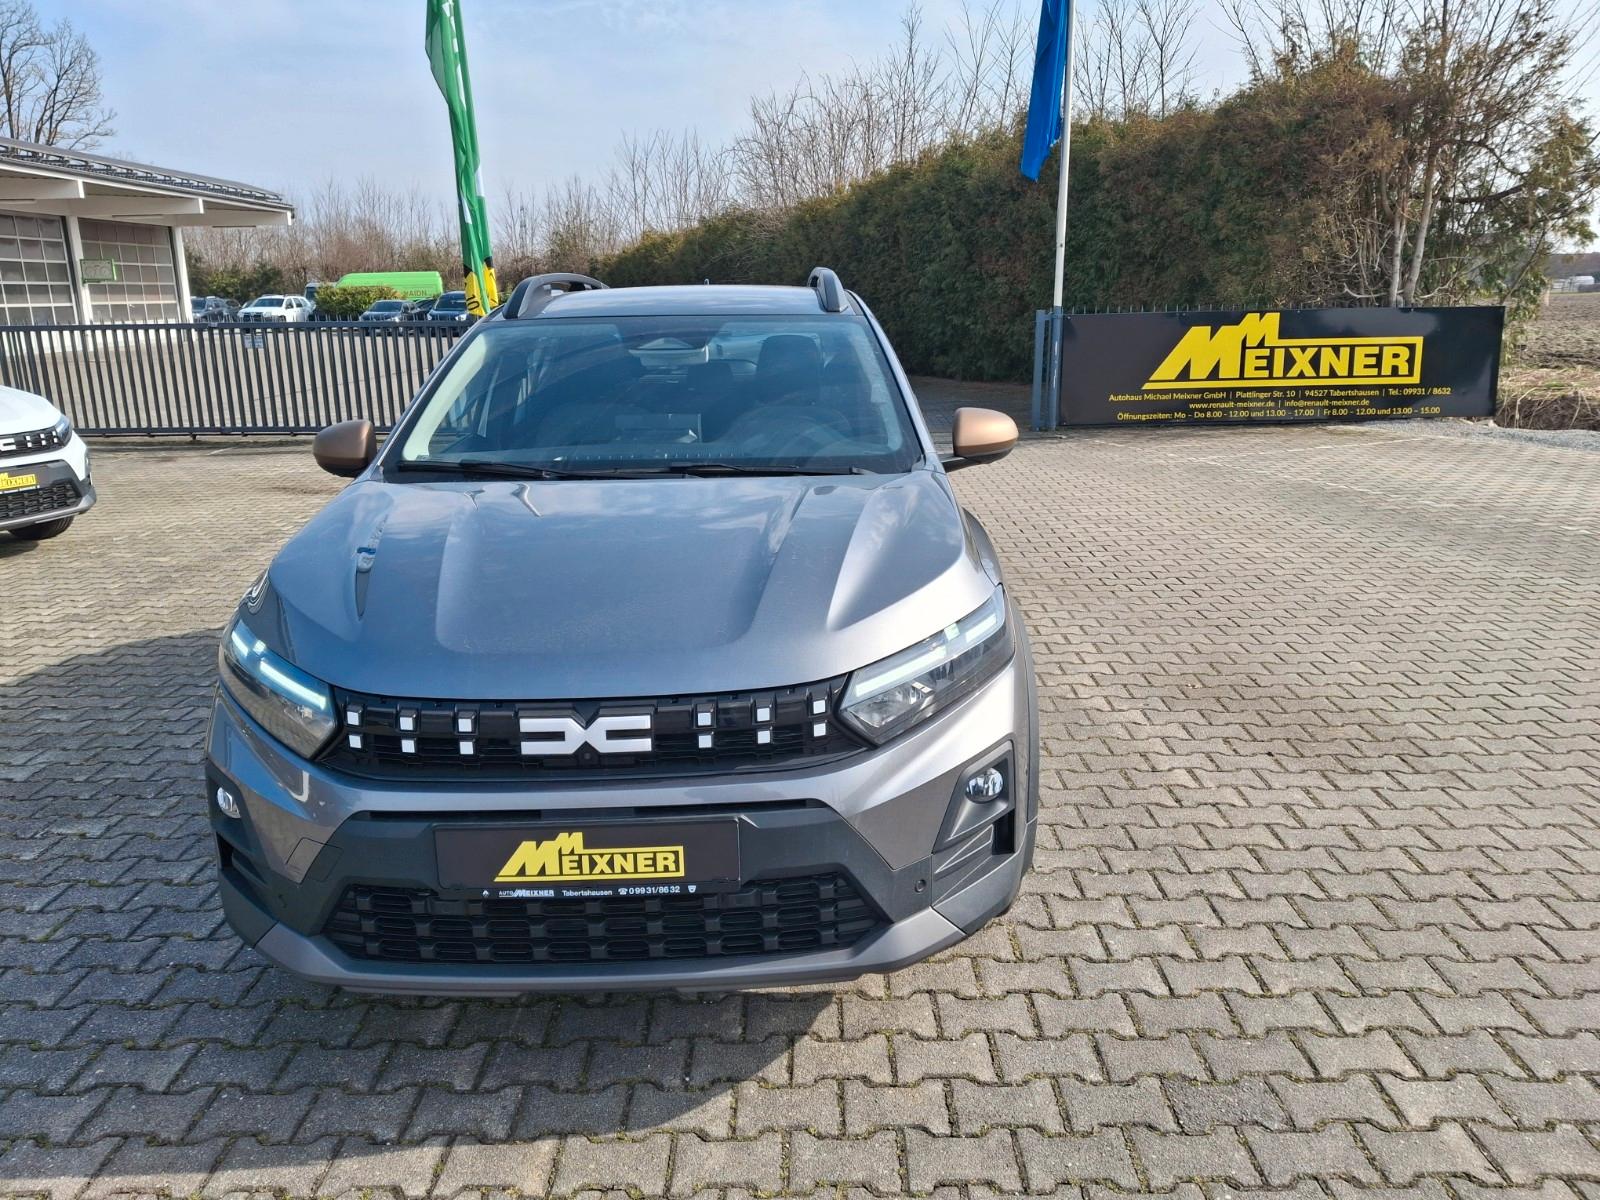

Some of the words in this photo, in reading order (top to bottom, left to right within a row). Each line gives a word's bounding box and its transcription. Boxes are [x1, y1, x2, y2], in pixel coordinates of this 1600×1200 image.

[1147, 325, 1411, 381] MEIXNER
[1173, 392, 1202, 400] Meixner
[1204, 391, 1226, 399] GmbH
[1236, 390, 1271, 399] Plattlinger
[1305, 389, 1328, 397] 94527
[1329, 389, 1379, 397] Tabertshausen
[1189, 401, 1274, 409] www.renault-meixner.de
[1285, 399, 1369, 407] info@renault-meixner.de
[498, 840, 677, 877] MEIXNER
